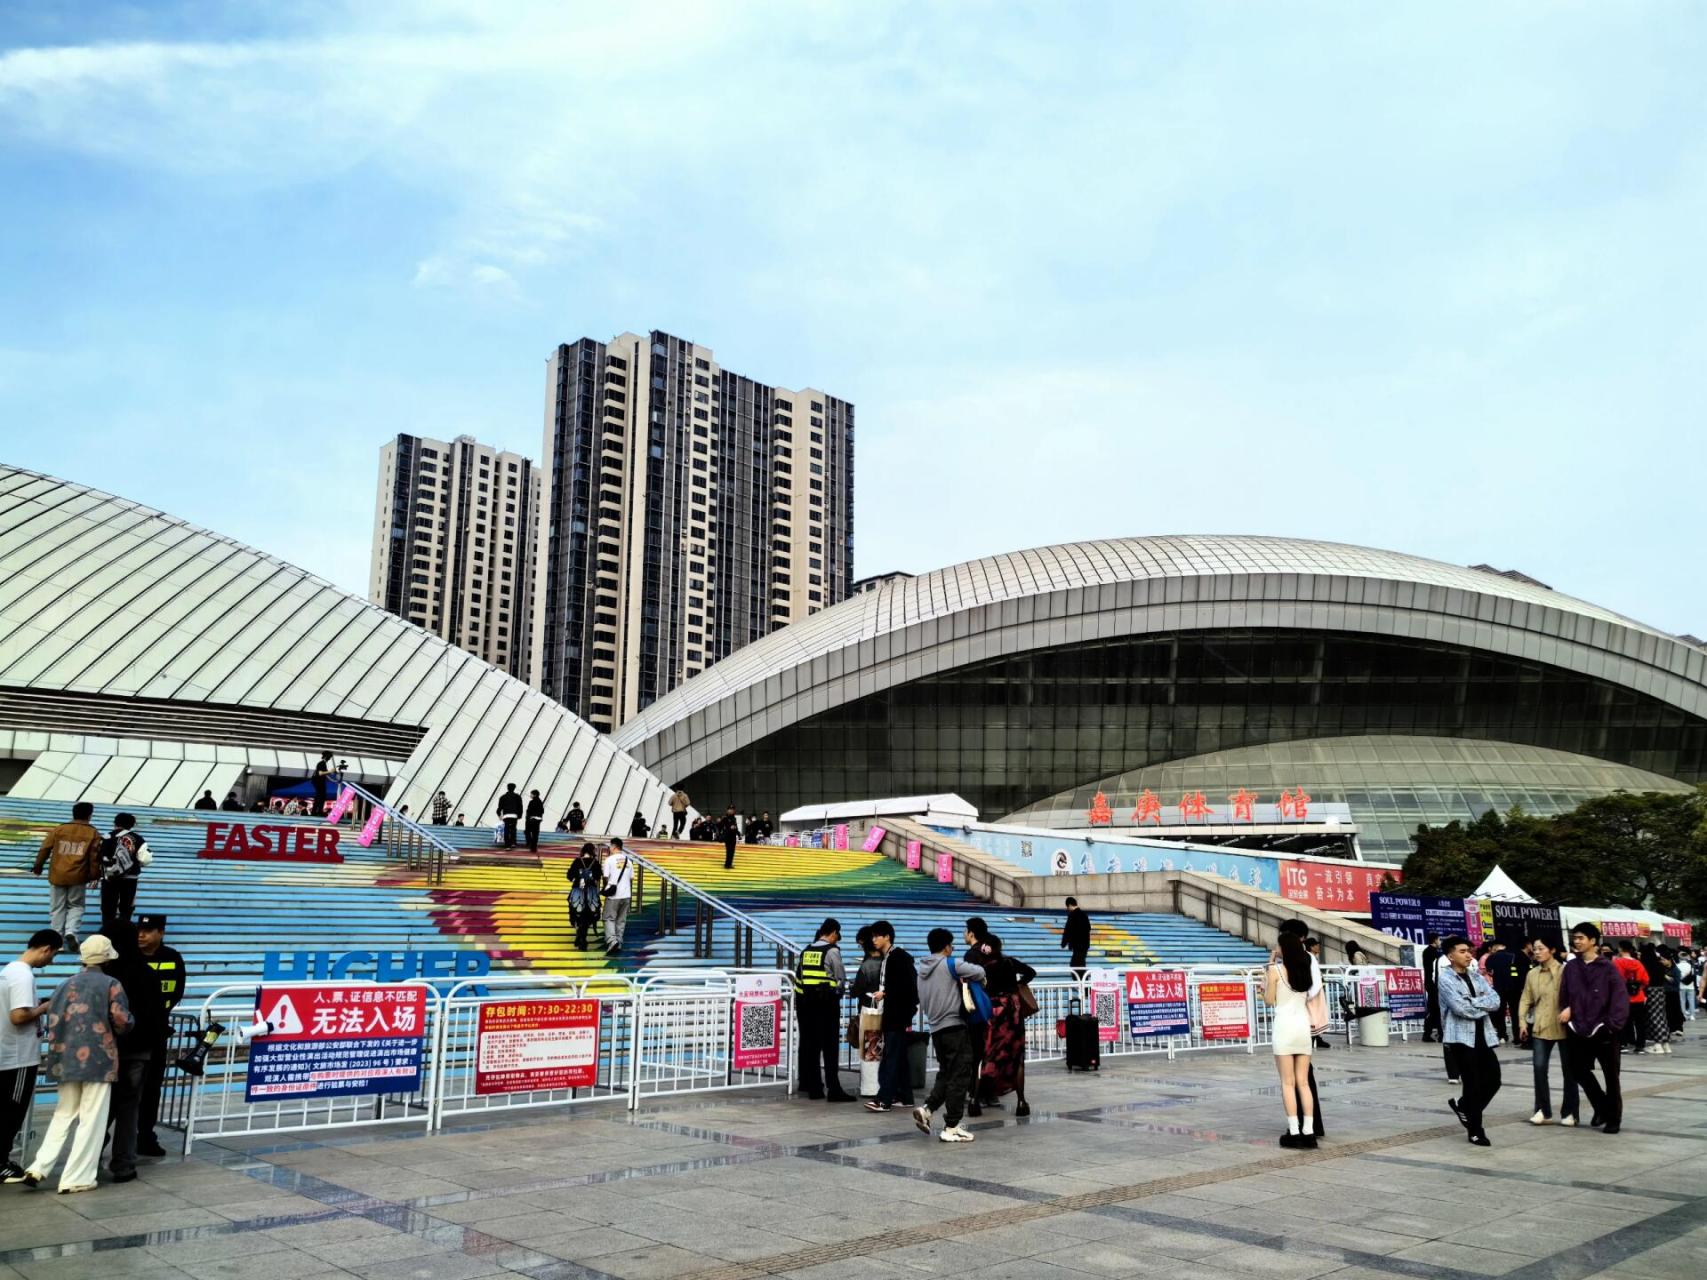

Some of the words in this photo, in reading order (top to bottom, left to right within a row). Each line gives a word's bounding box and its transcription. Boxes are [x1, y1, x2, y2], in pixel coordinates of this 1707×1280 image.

[1086, 786, 1311, 825] 嘉庚体育馆
[203, 821, 342, 858] FASTER
[1286, 867, 1308, 887] ITG
[1314, 869, 1353, 885] 一流引领
[1315, 886, 1355, 902] 奋斗为本
[1379, 896, 1395, 905] SOUL
[1395, 898, 1416, 907] POWER
[1494, 904, 1519, 918] SOUL
[1520, 906, 1552, 920] POWER
[1146, 983, 1184, 999] 无法入场
[1397, 978, 1422, 991] 无法入场
[313, 990, 418, 1004] 人、票、证信息不匹配
[310, 1005, 417, 1035] 无法入场
